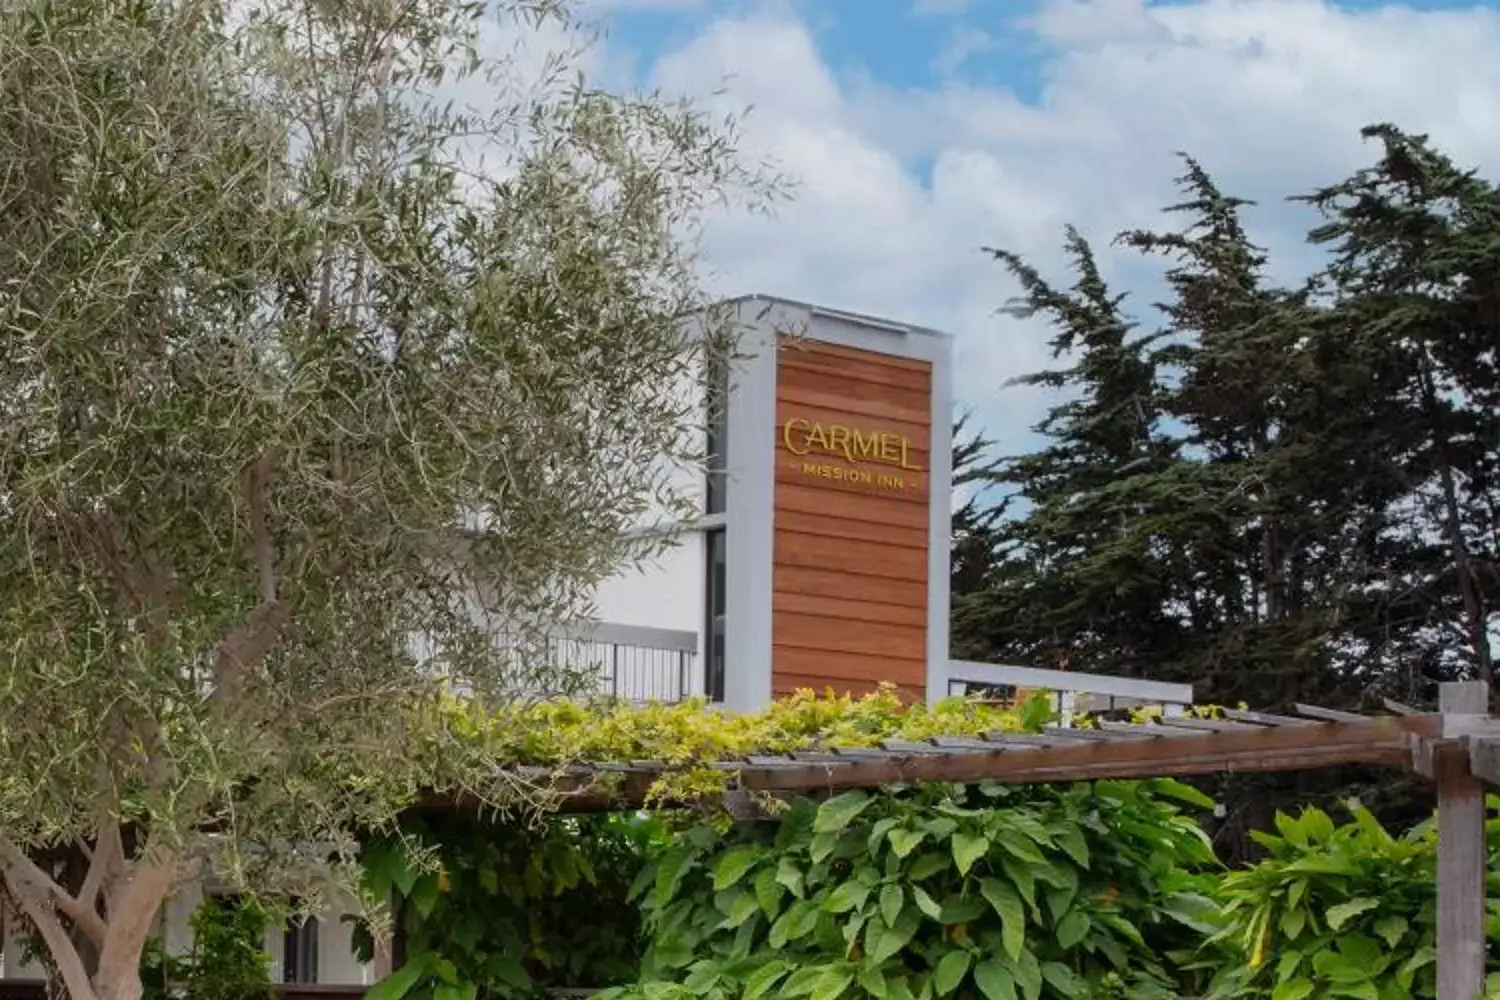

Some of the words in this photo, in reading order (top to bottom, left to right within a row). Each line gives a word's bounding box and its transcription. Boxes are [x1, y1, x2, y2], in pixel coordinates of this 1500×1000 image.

[783, 418, 922, 470] CARMEL
[802, 462, 871, 484] MISSION
[876, 472, 904, 491] INN
